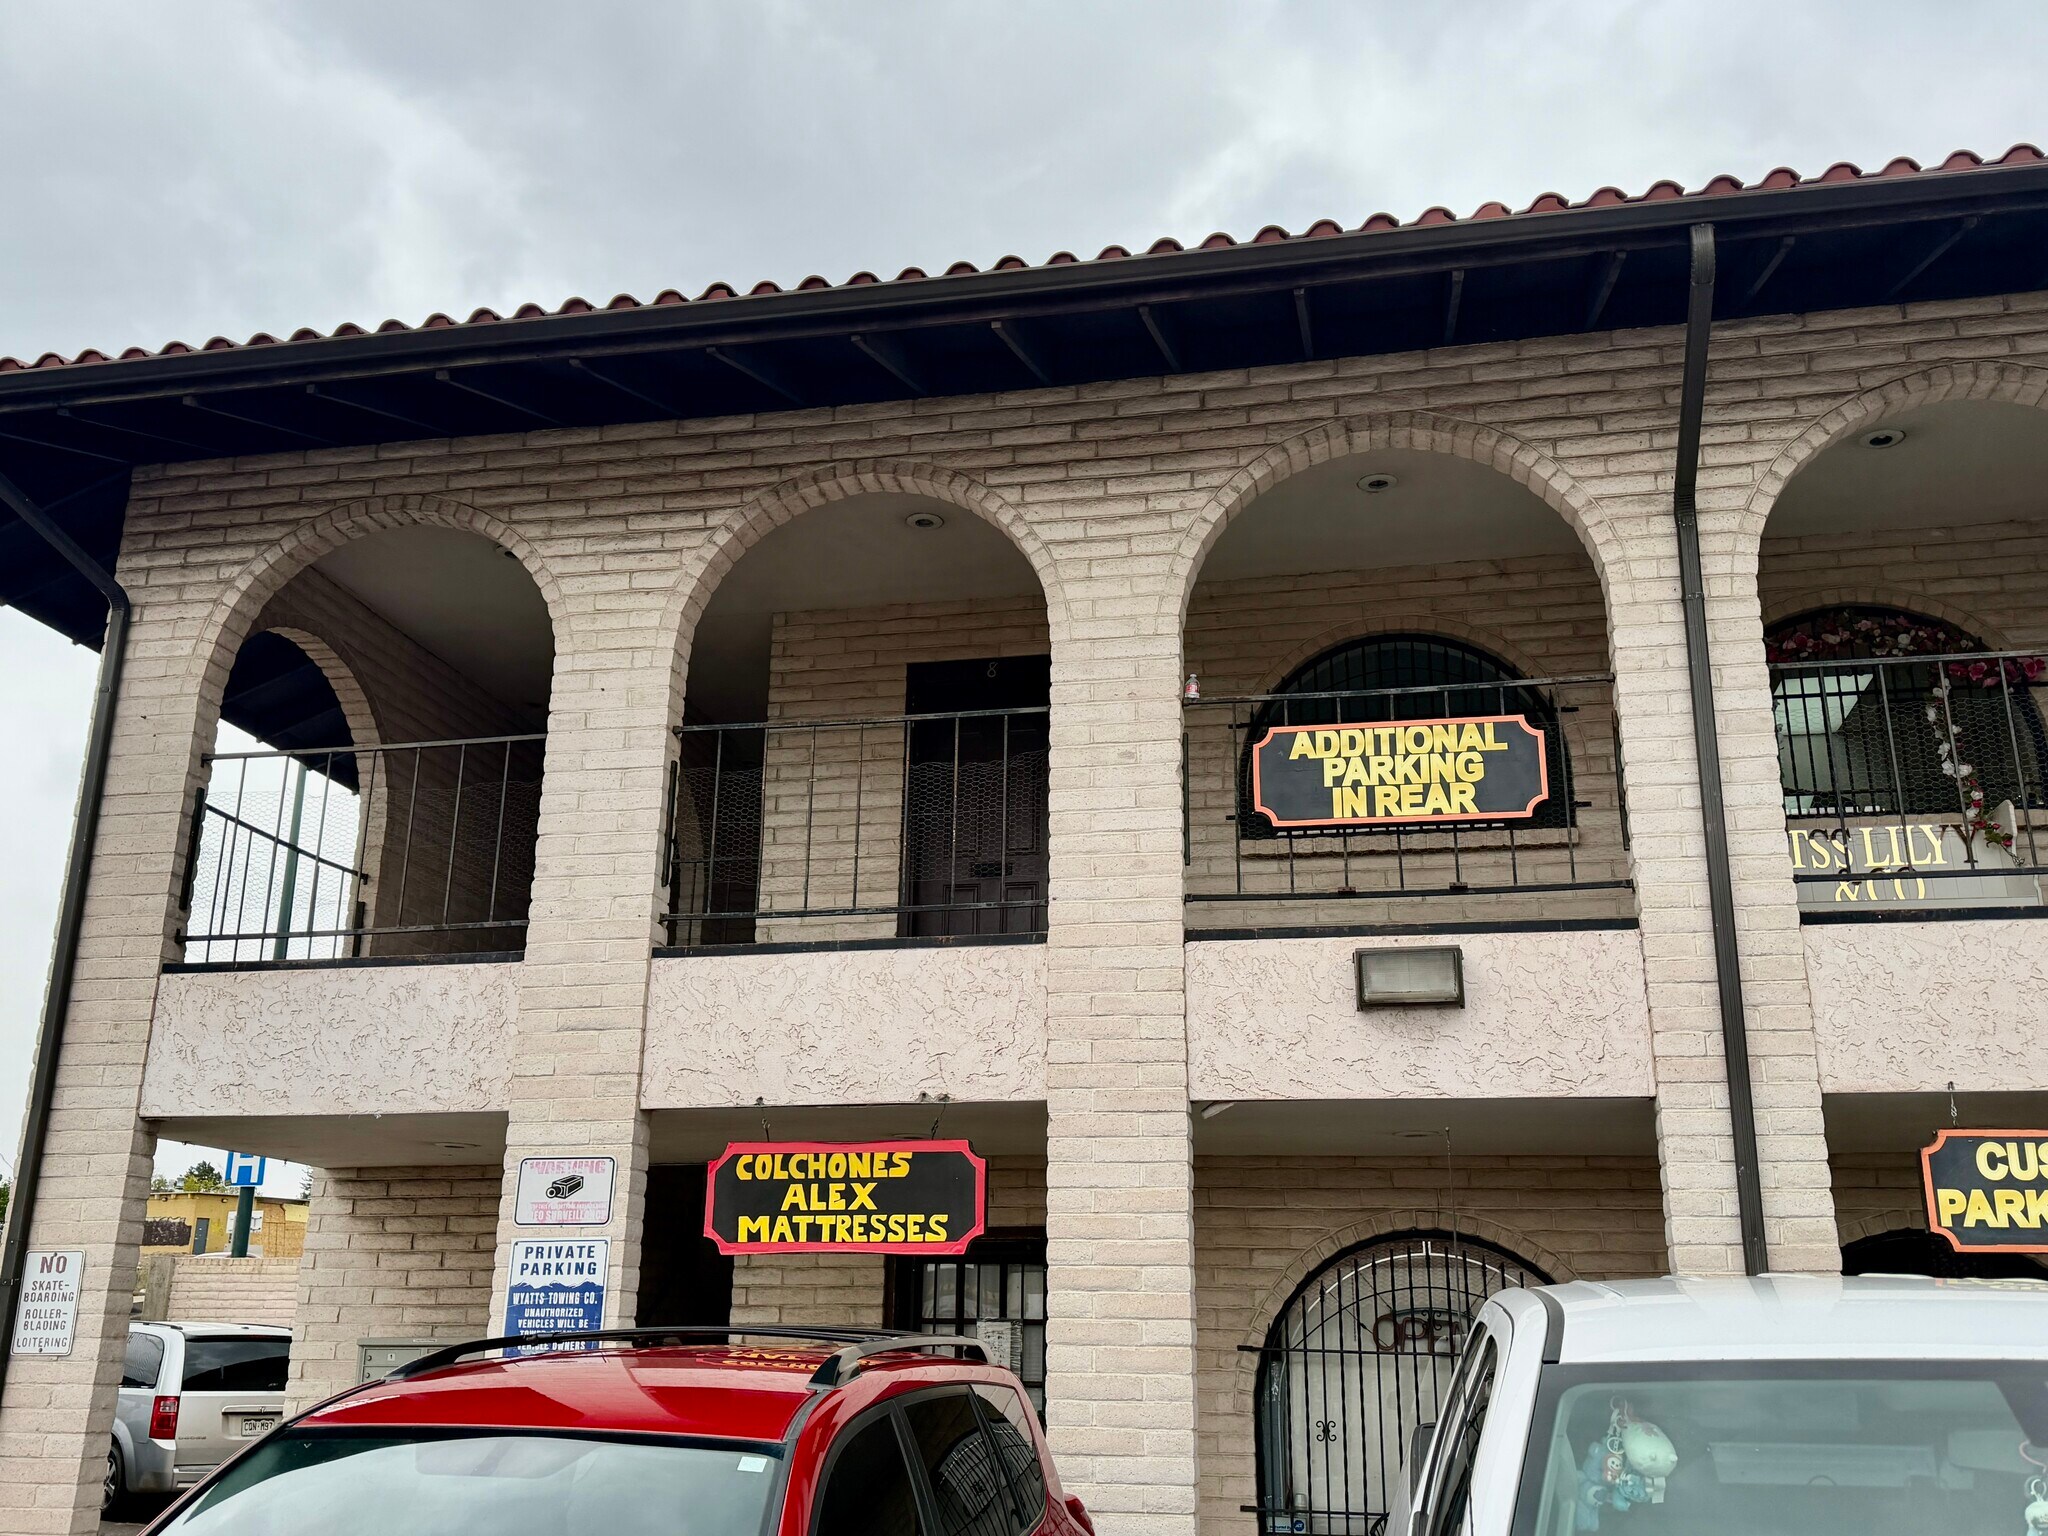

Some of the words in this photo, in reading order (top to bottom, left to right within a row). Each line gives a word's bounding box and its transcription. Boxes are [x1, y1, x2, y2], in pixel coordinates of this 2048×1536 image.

[986, 661, 999, 678] 8
[1289, 722, 1508, 760] ADDITIONAL
[1323, 751, 1485, 788] PARKING
[1332, 785, 1368, 818] IN
[1374, 782, 1480, 817] REAR
[230, 1152, 260, 1184] H
[735, 1152, 913, 1181] COLCHONES
[780, 1182, 878, 1211] ALEX
[737, 1214, 949, 1243] MATTRESSES
[524, 1245, 596, 1260] PRIVATE
[39, 1255, 68, 1274] NO
[520, 1262, 597, 1276] PARKING
[31, 1280, 70, 1291] SKATE-
[23, 1291, 75, 1303] BOARDING
[512, 1292, 545, 1305] WYATTS
[548, 1291, 581, 1305] TOWING
[583, 1291, 598, 1305] CO.
[24, 1308, 68, 1320] ROLLER-
[524, 1307, 584, 1318] UNAUTHORIZED
[23, 1320, 67, 1331] BLADING
[517, 1318, 555, 1329] VEHICLES
[557, 1318, 576, 1329] WILL
[578, 1318, 589, 1329] BE
[16, 1336, 68, 1348] LOITERING
[552, 1341, 586, 1351] OWNERS
